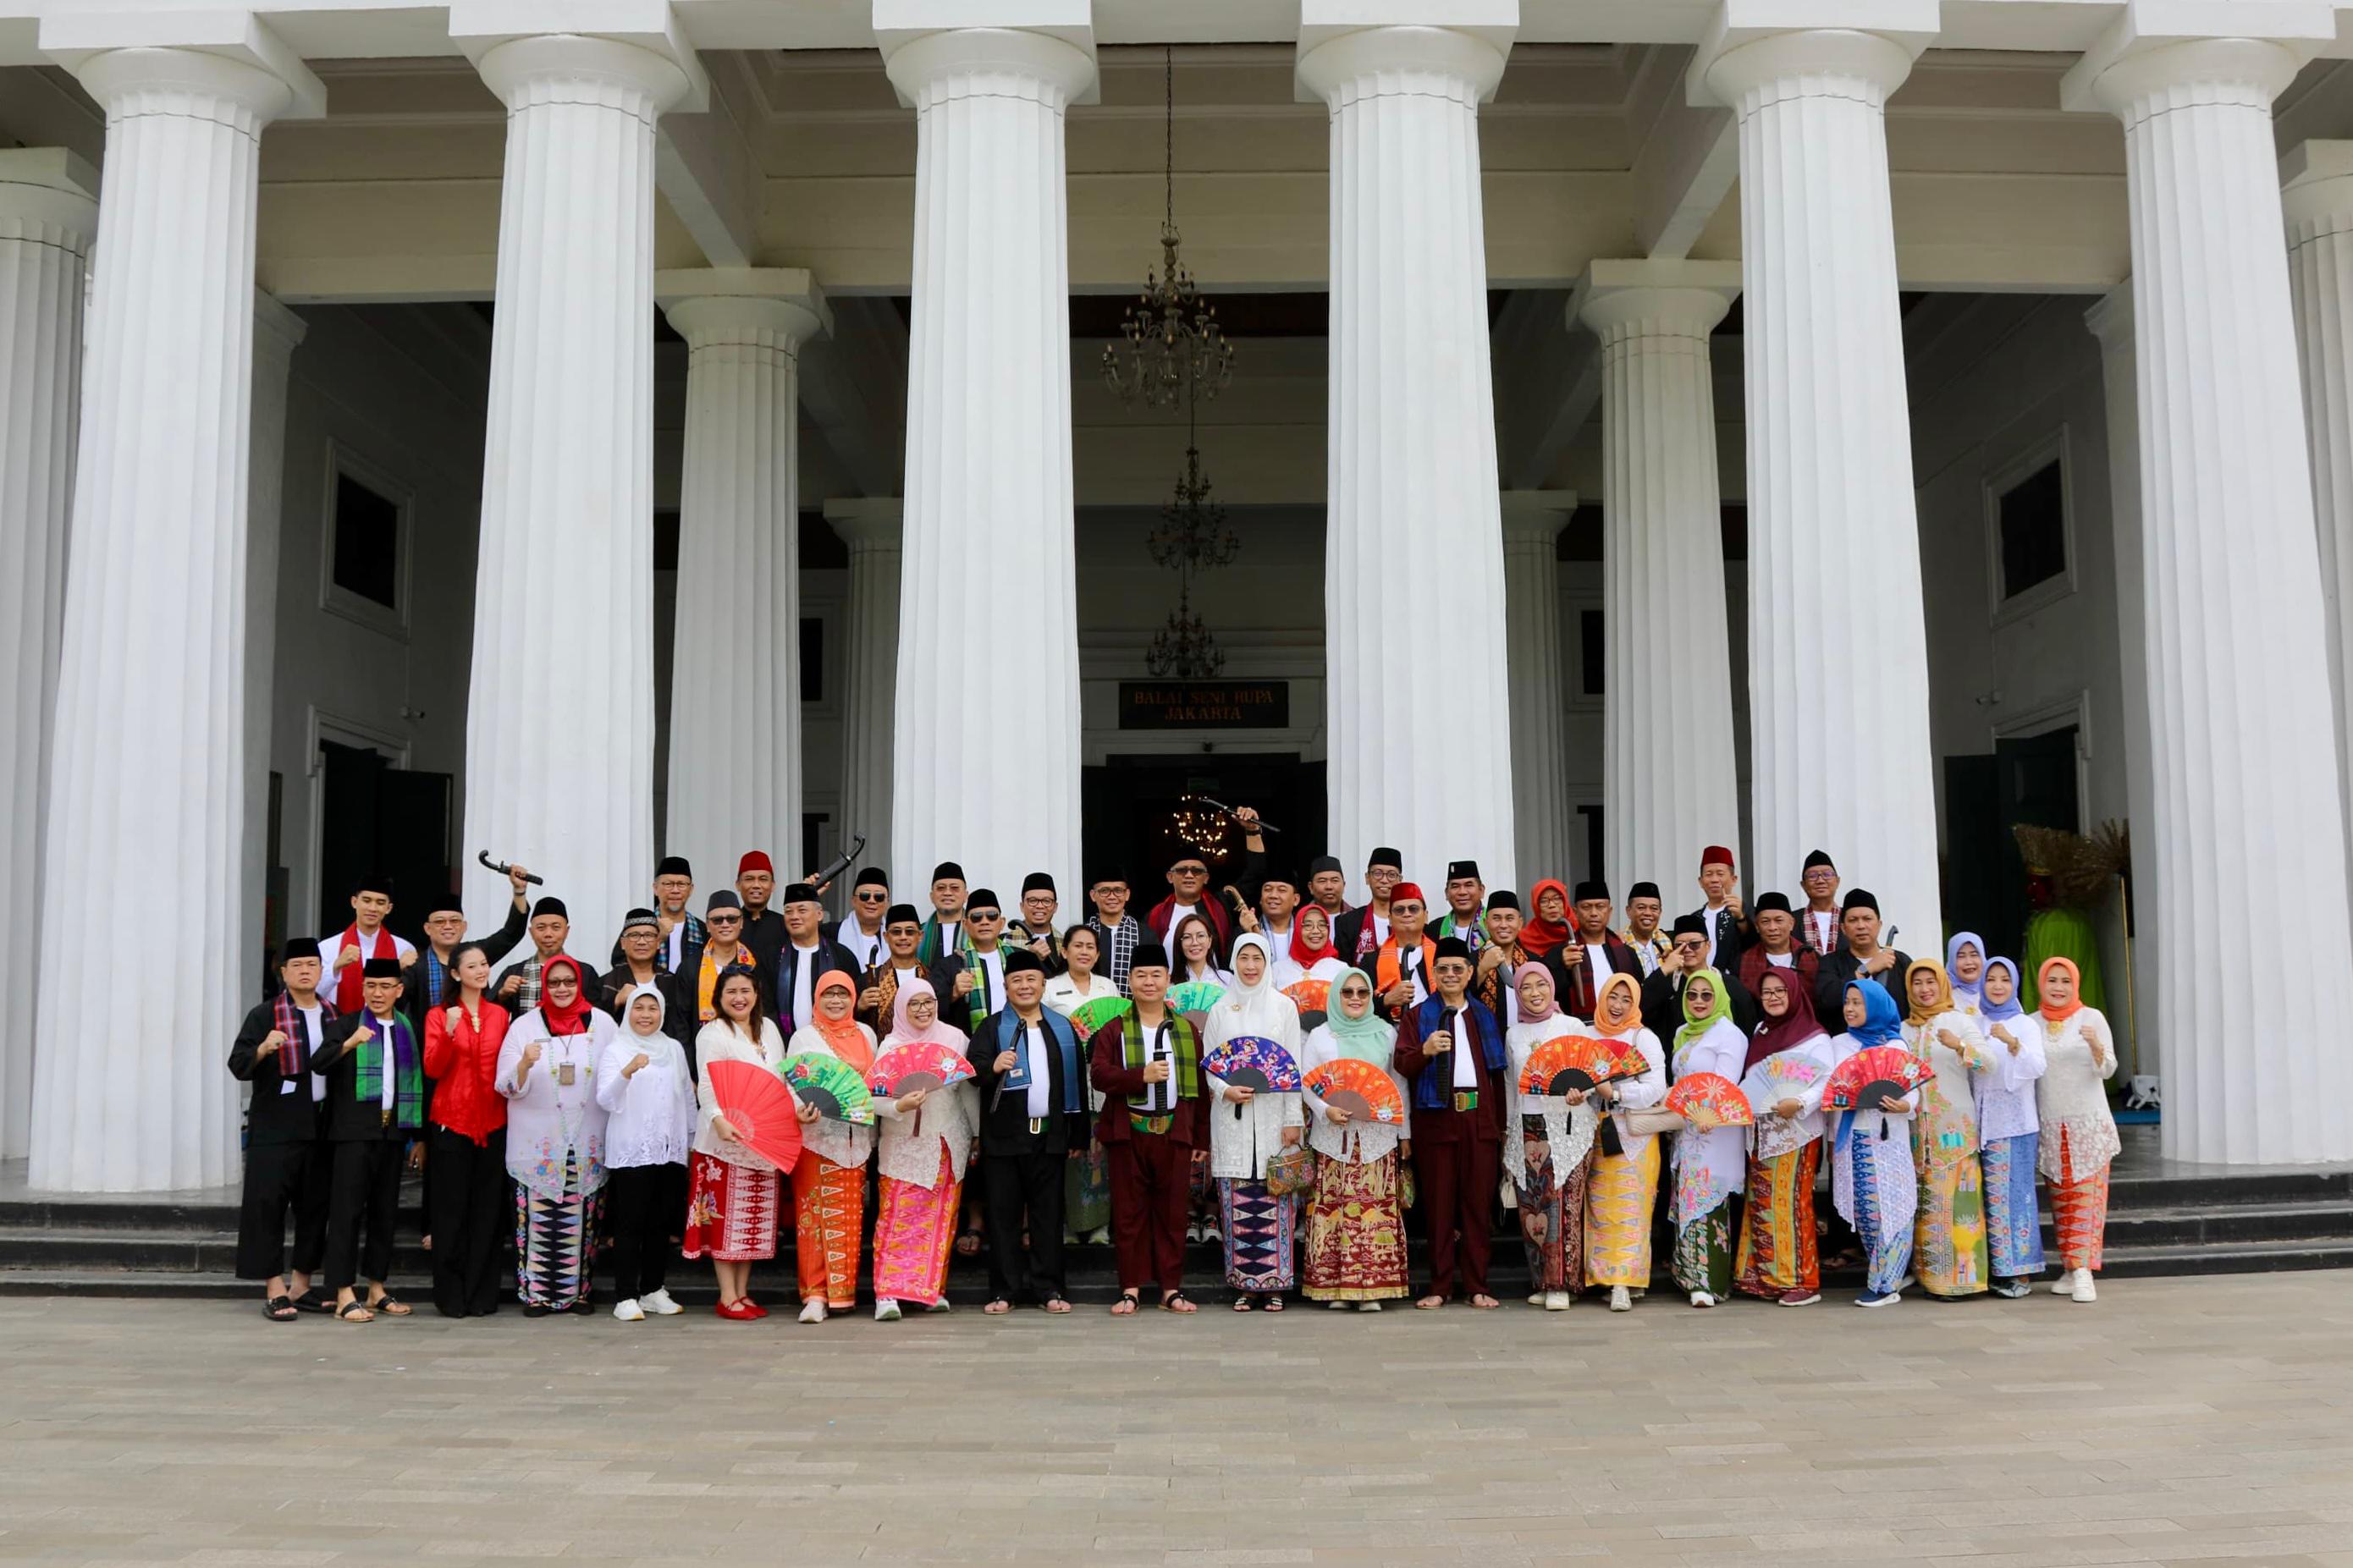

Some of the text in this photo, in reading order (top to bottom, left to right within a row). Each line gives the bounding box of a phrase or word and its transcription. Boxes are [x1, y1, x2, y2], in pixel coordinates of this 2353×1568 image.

[1135, 690, 1273, 705] BALAI SENI RUPA
[1165, 706, 1243, 720] JAKARTA
